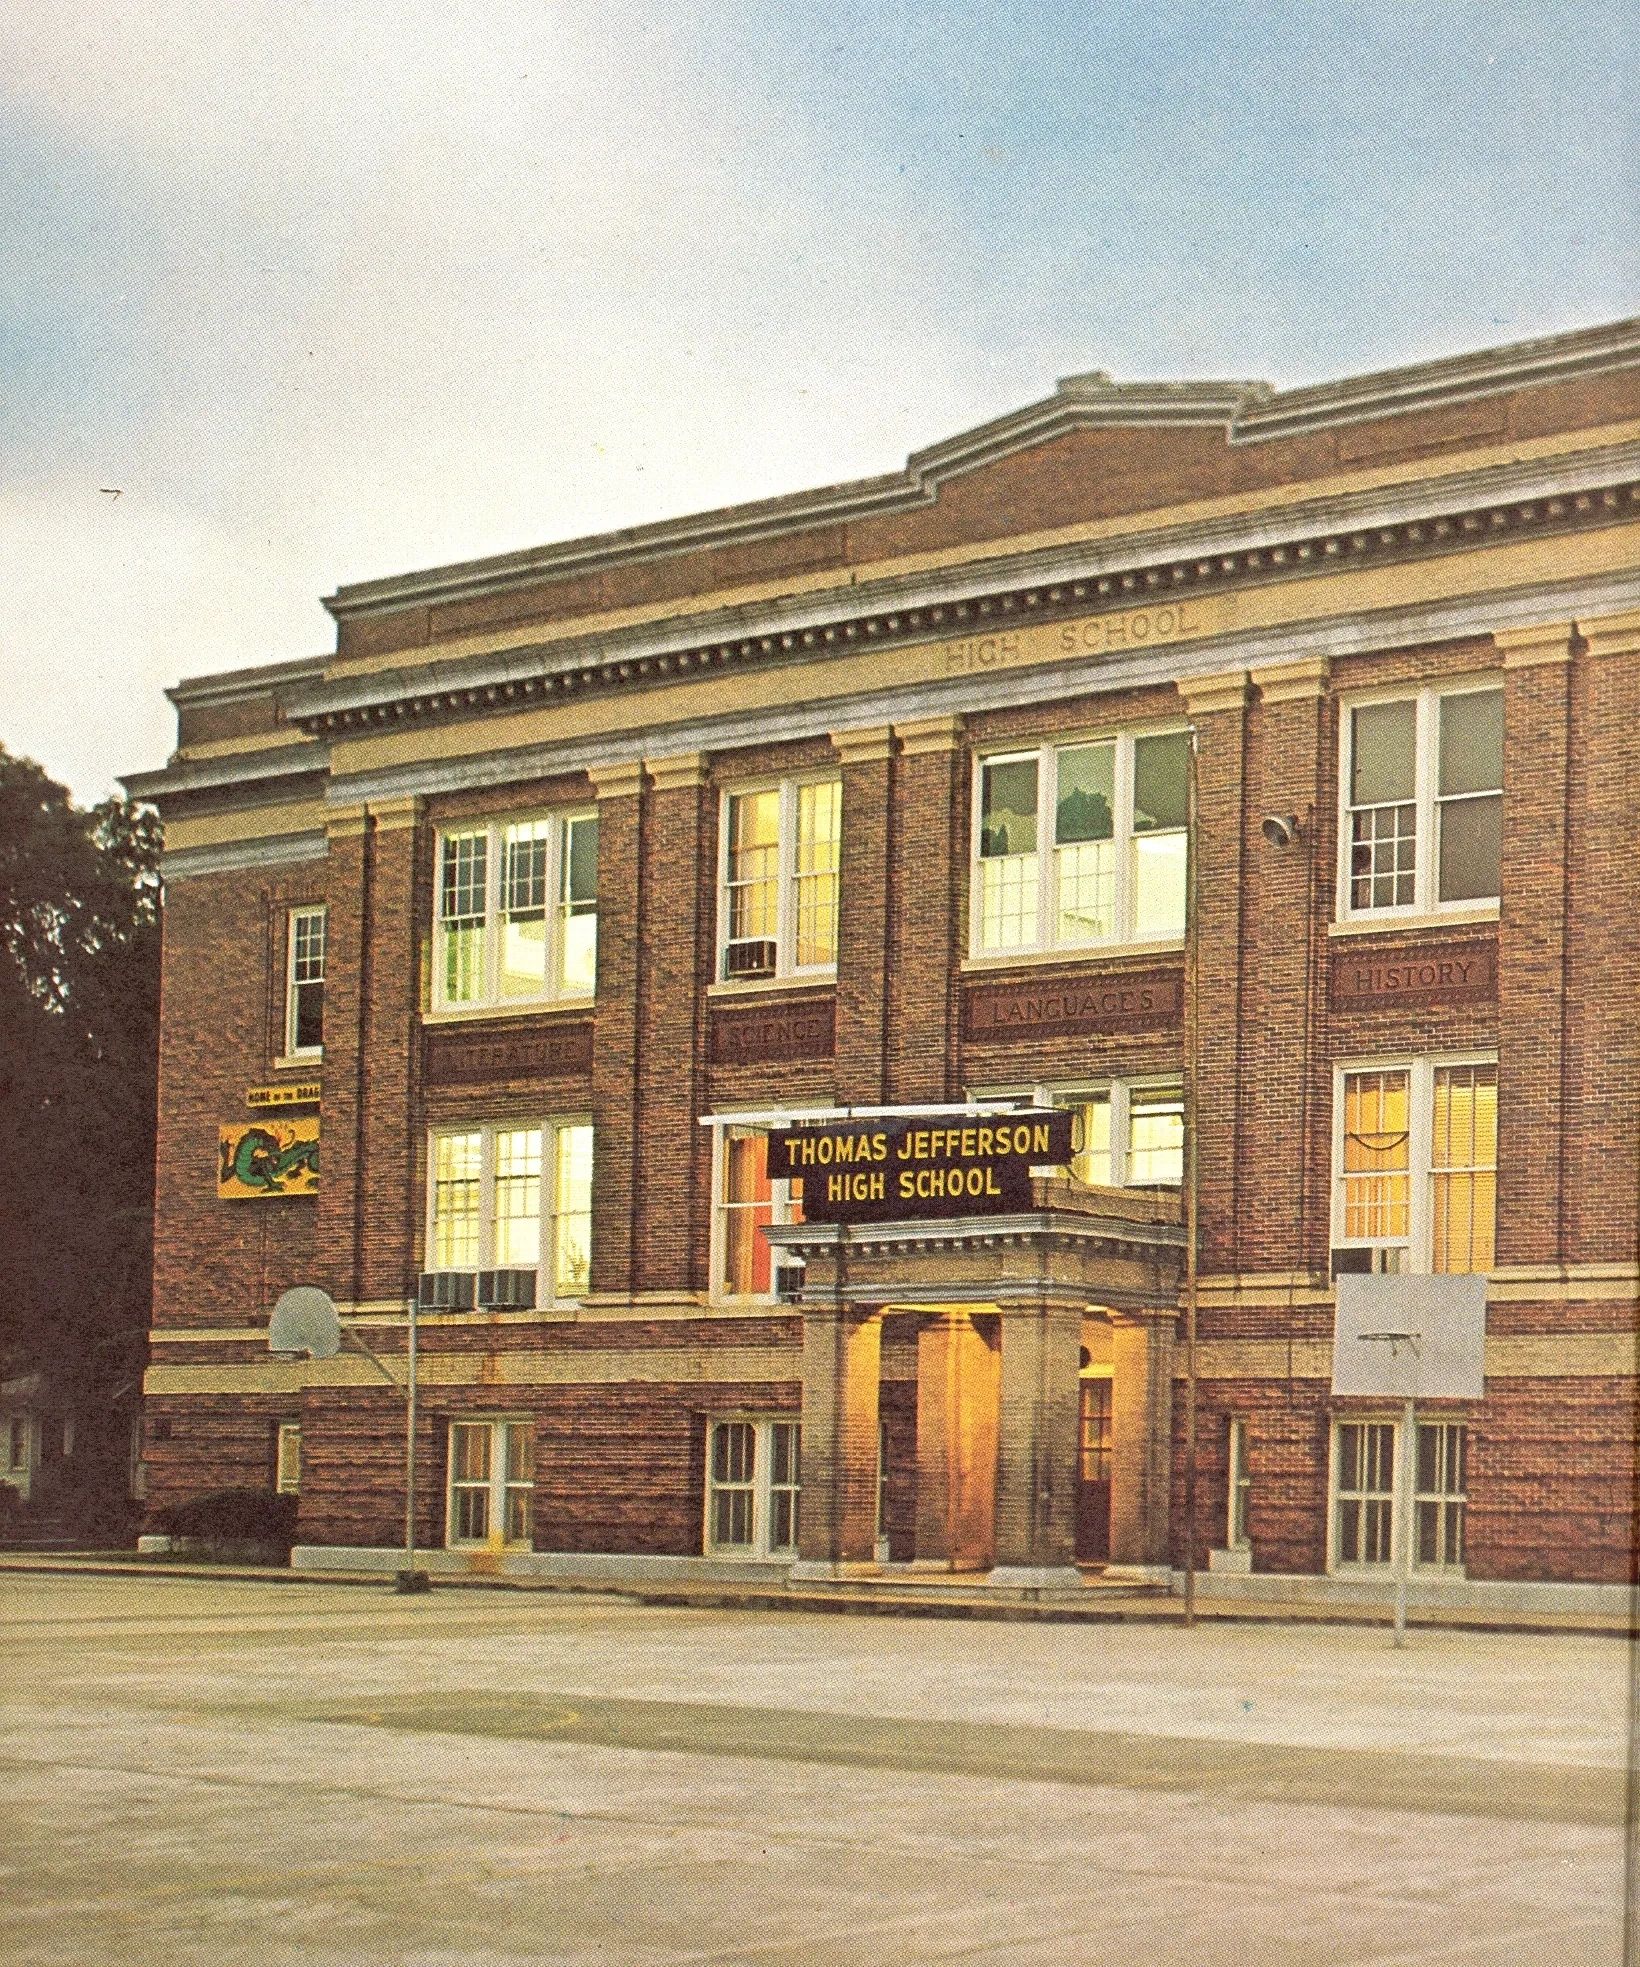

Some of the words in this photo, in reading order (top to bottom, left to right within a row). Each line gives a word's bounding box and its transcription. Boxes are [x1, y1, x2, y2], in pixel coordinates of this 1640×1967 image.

[947, 635, 1019, 670] HIGH
[1059, 606, 1199, 651] SCHOOL
[1355, 961, 1477, 991] HISTORY
[993, 989, 1154, 1023] LANGUAGES
[729, 1019, 821, 1047] SCIENCE
[785, 1133, 888, 1166] THOMAS
[897, 1124, 1050, 1161] JEFFERSON
[828, 1172, 885, 1202] HIGH
[899, 1167, 1001, 1199] SCHOOL
